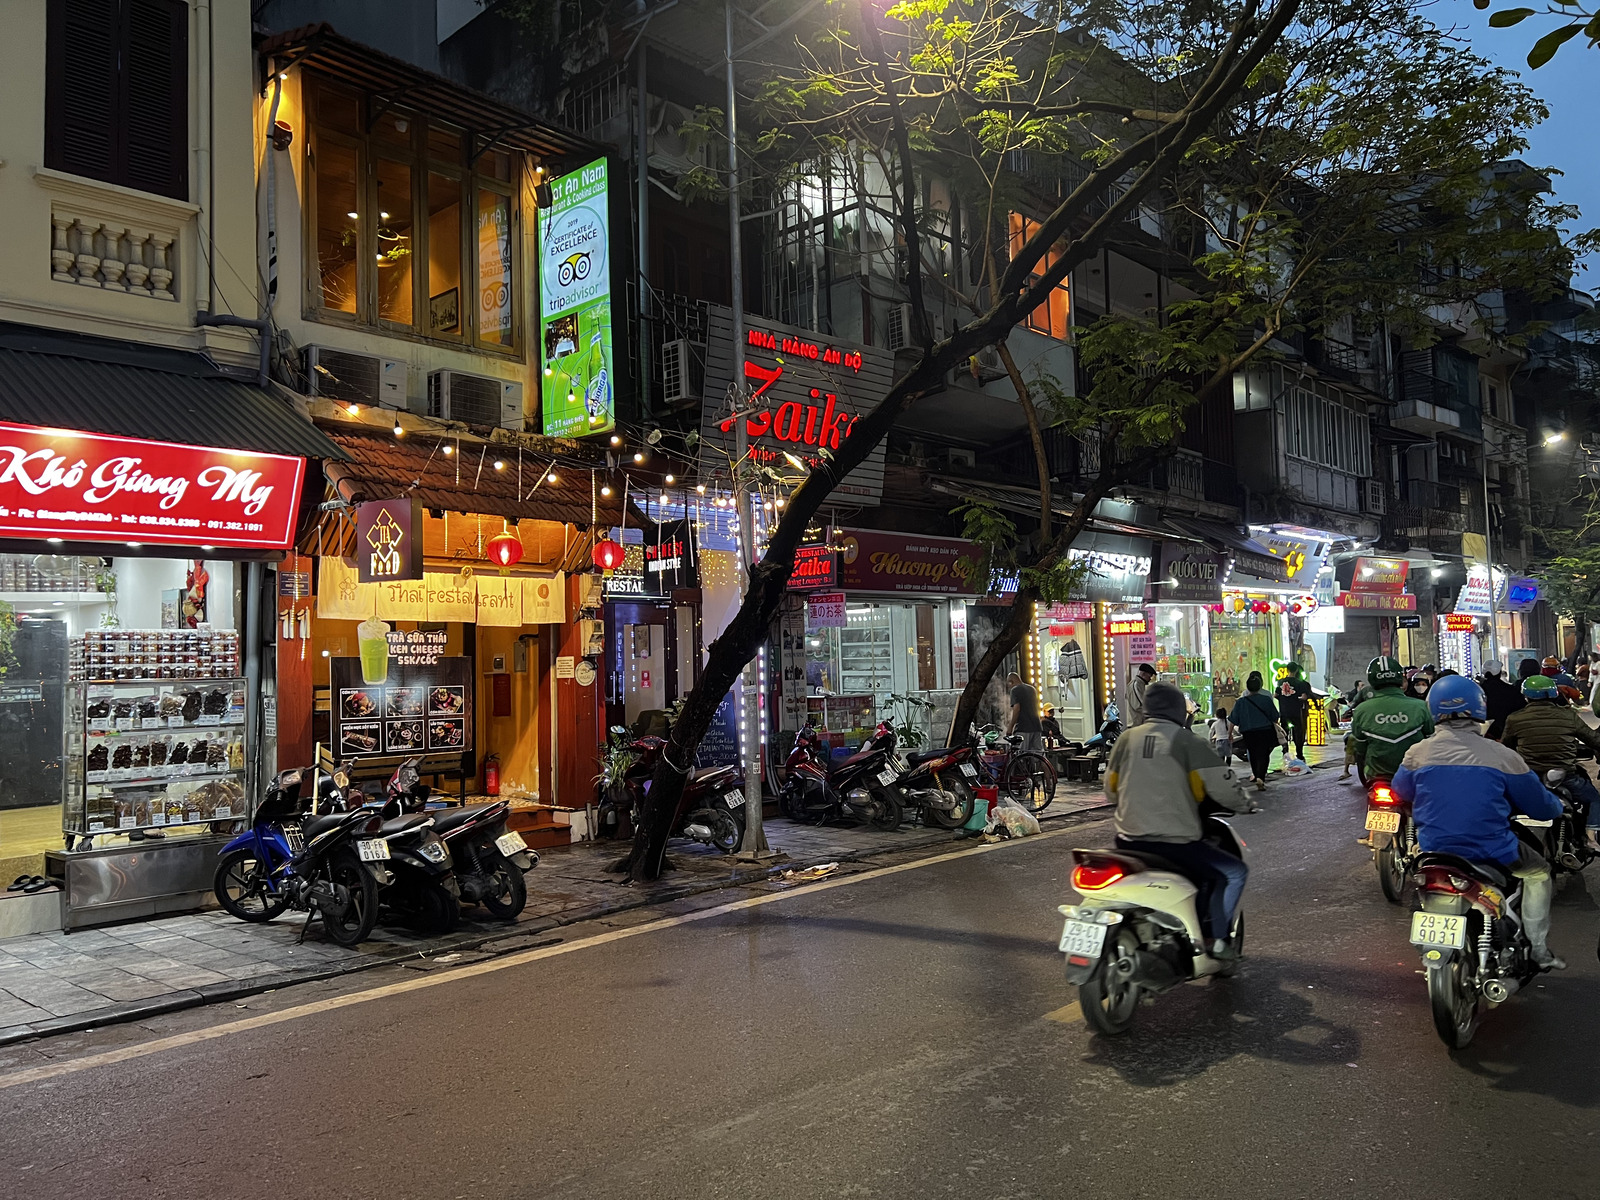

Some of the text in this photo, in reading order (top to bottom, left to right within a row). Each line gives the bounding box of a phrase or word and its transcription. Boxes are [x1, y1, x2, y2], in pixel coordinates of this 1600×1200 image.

[565, 178, 578, 195] An
[581, 165, 605, 187] Nam
[551, 229, 597, 256] EXCELLENCE
[554, 225, 587, 244] CERTIFICATE
[549, 284, 600, 311] tripadvisor
[782, 336, 819, 360] HÀNG
[554, 419, 562, 428] 11
[0, 446, 88, 496] Khô
[83, 456, 190, 510] Giang
[791, 557, 831, 578] Zaika
[1135, 556, 1152, 577] 29
[1170, 555, 1198, 578] QUỐC
[1199, 559, 1219, 583] VIỆT
[427, 586, 515, 609] restaurant
[1393, 597, 1409, 609] 2024
[810, 604, 843, 618] 蓮のお茶
[386, 630, 447, 643] TRÀ SỮA THÁI
[390, 644, 444, 654] KEM CHEESE
[1376, 671, 1395, 679] Grab
[1375, 711, 1409, 724] Grab
[1420, 915, 1458, 931] 29-X2
[1418, 928, 1456, 945] 9031
